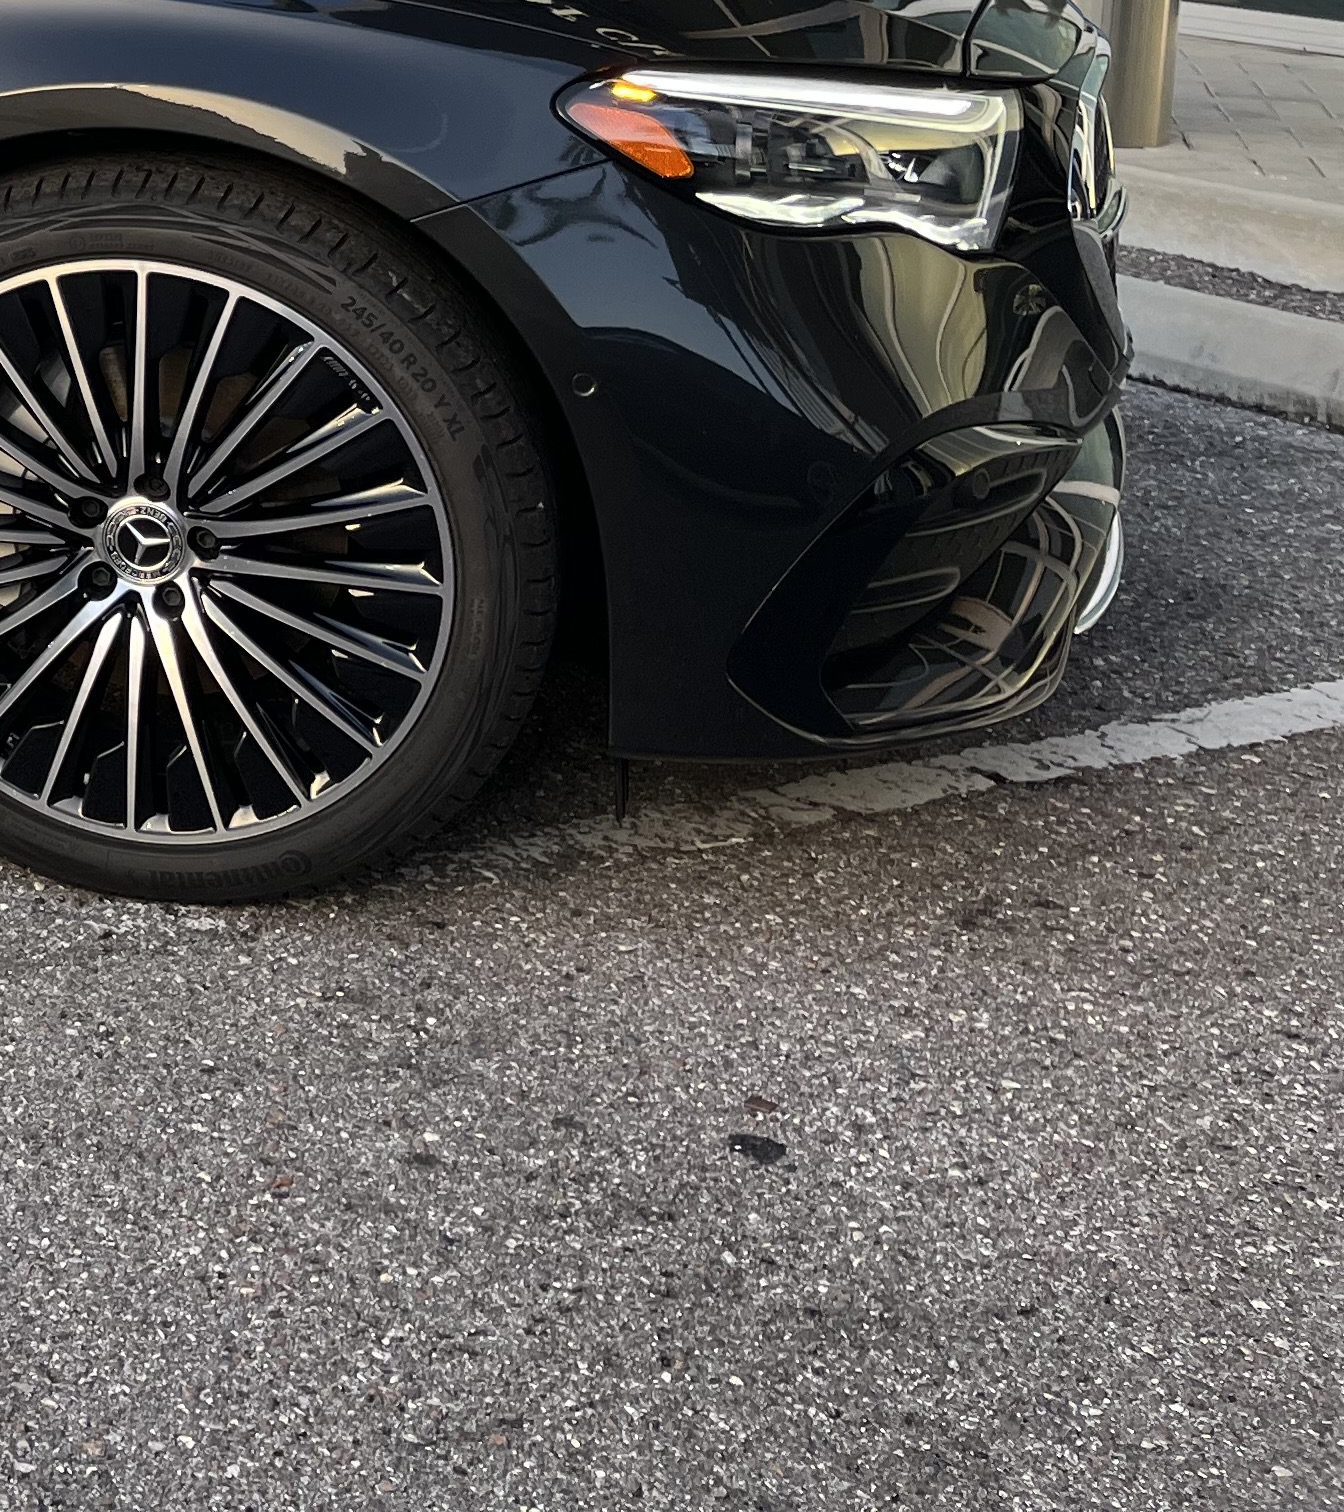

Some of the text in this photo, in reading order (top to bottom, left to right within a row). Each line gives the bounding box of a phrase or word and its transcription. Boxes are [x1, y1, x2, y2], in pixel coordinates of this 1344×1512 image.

[341, 296, 405, 354] 245/40
[443, 413, 464, 442] XL
[140, 506, 168, 522] BENZ
